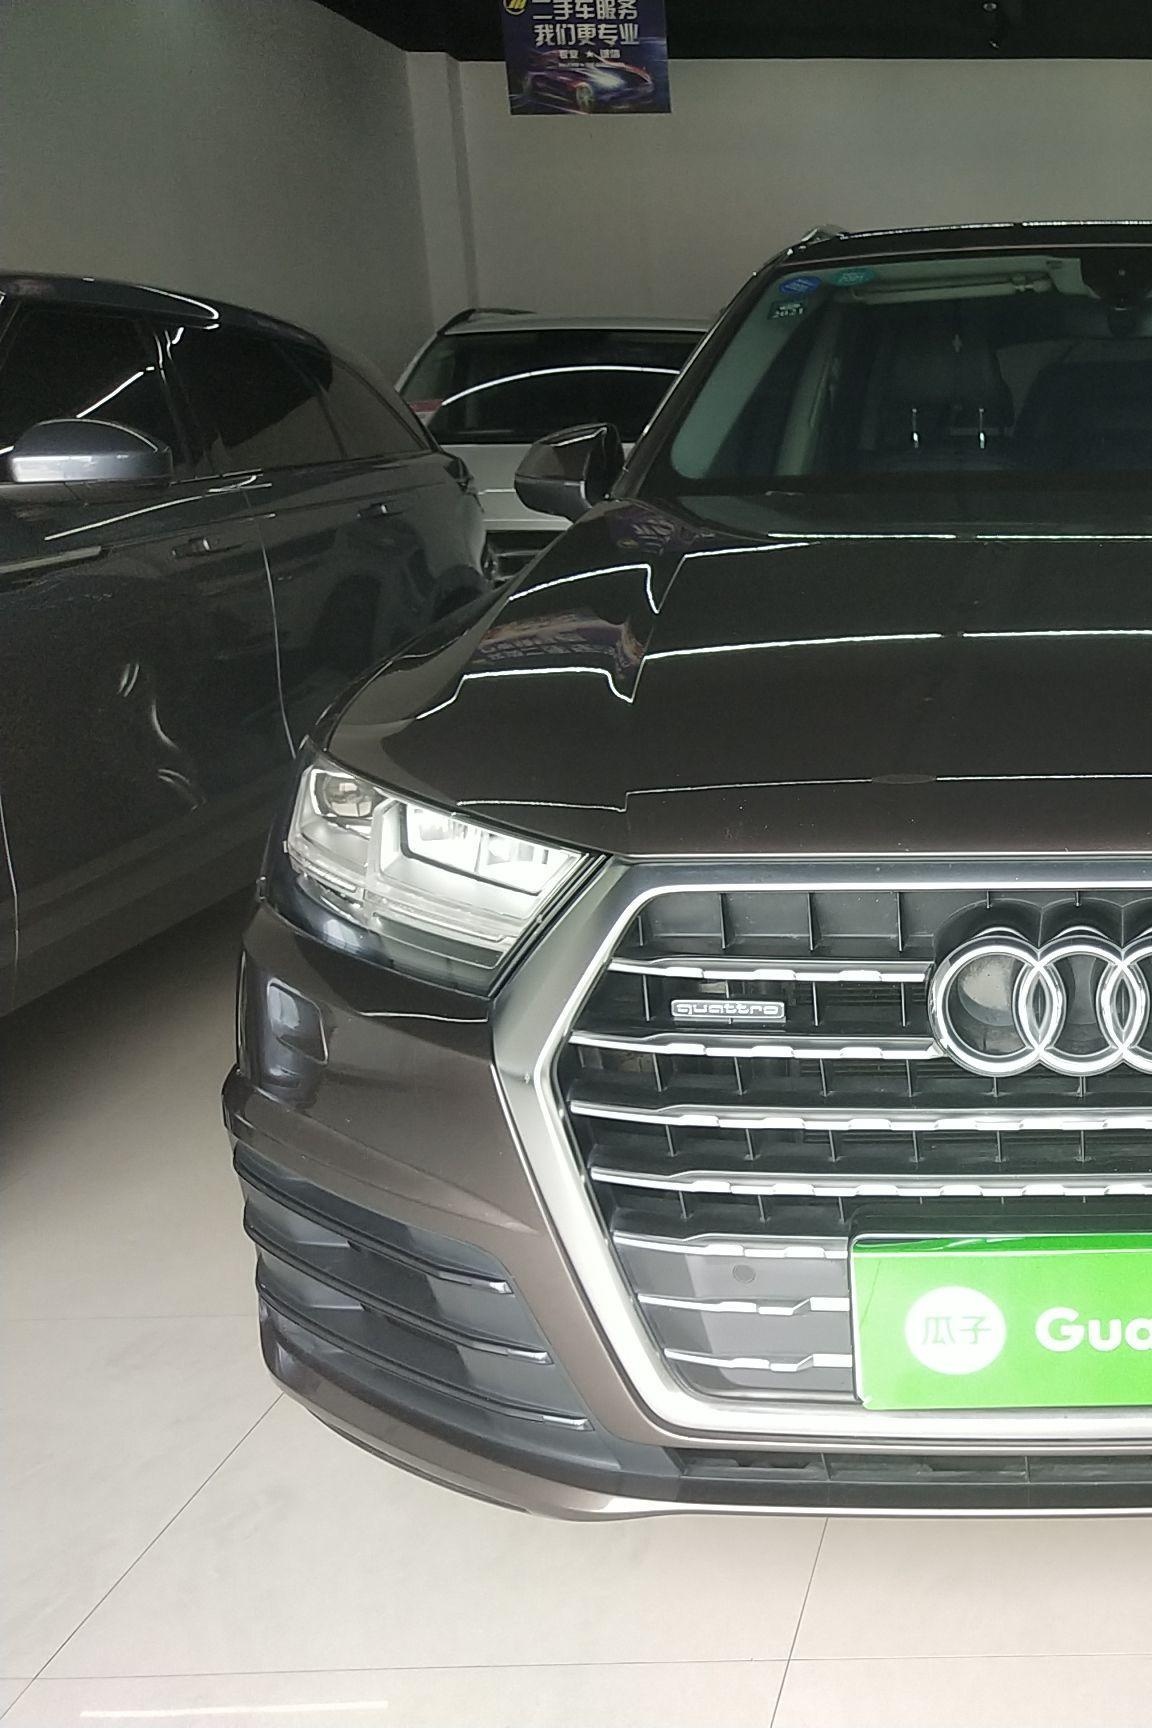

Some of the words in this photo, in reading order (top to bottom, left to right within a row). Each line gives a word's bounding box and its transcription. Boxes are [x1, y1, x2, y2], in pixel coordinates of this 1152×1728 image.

[532, 0, 638, 20] 二手车服务
[533, 23, 640, 46] 我们更专业
[676, 1003, 779, 1015] quattro
[921, 1315, 992, 1345] 瓜子
